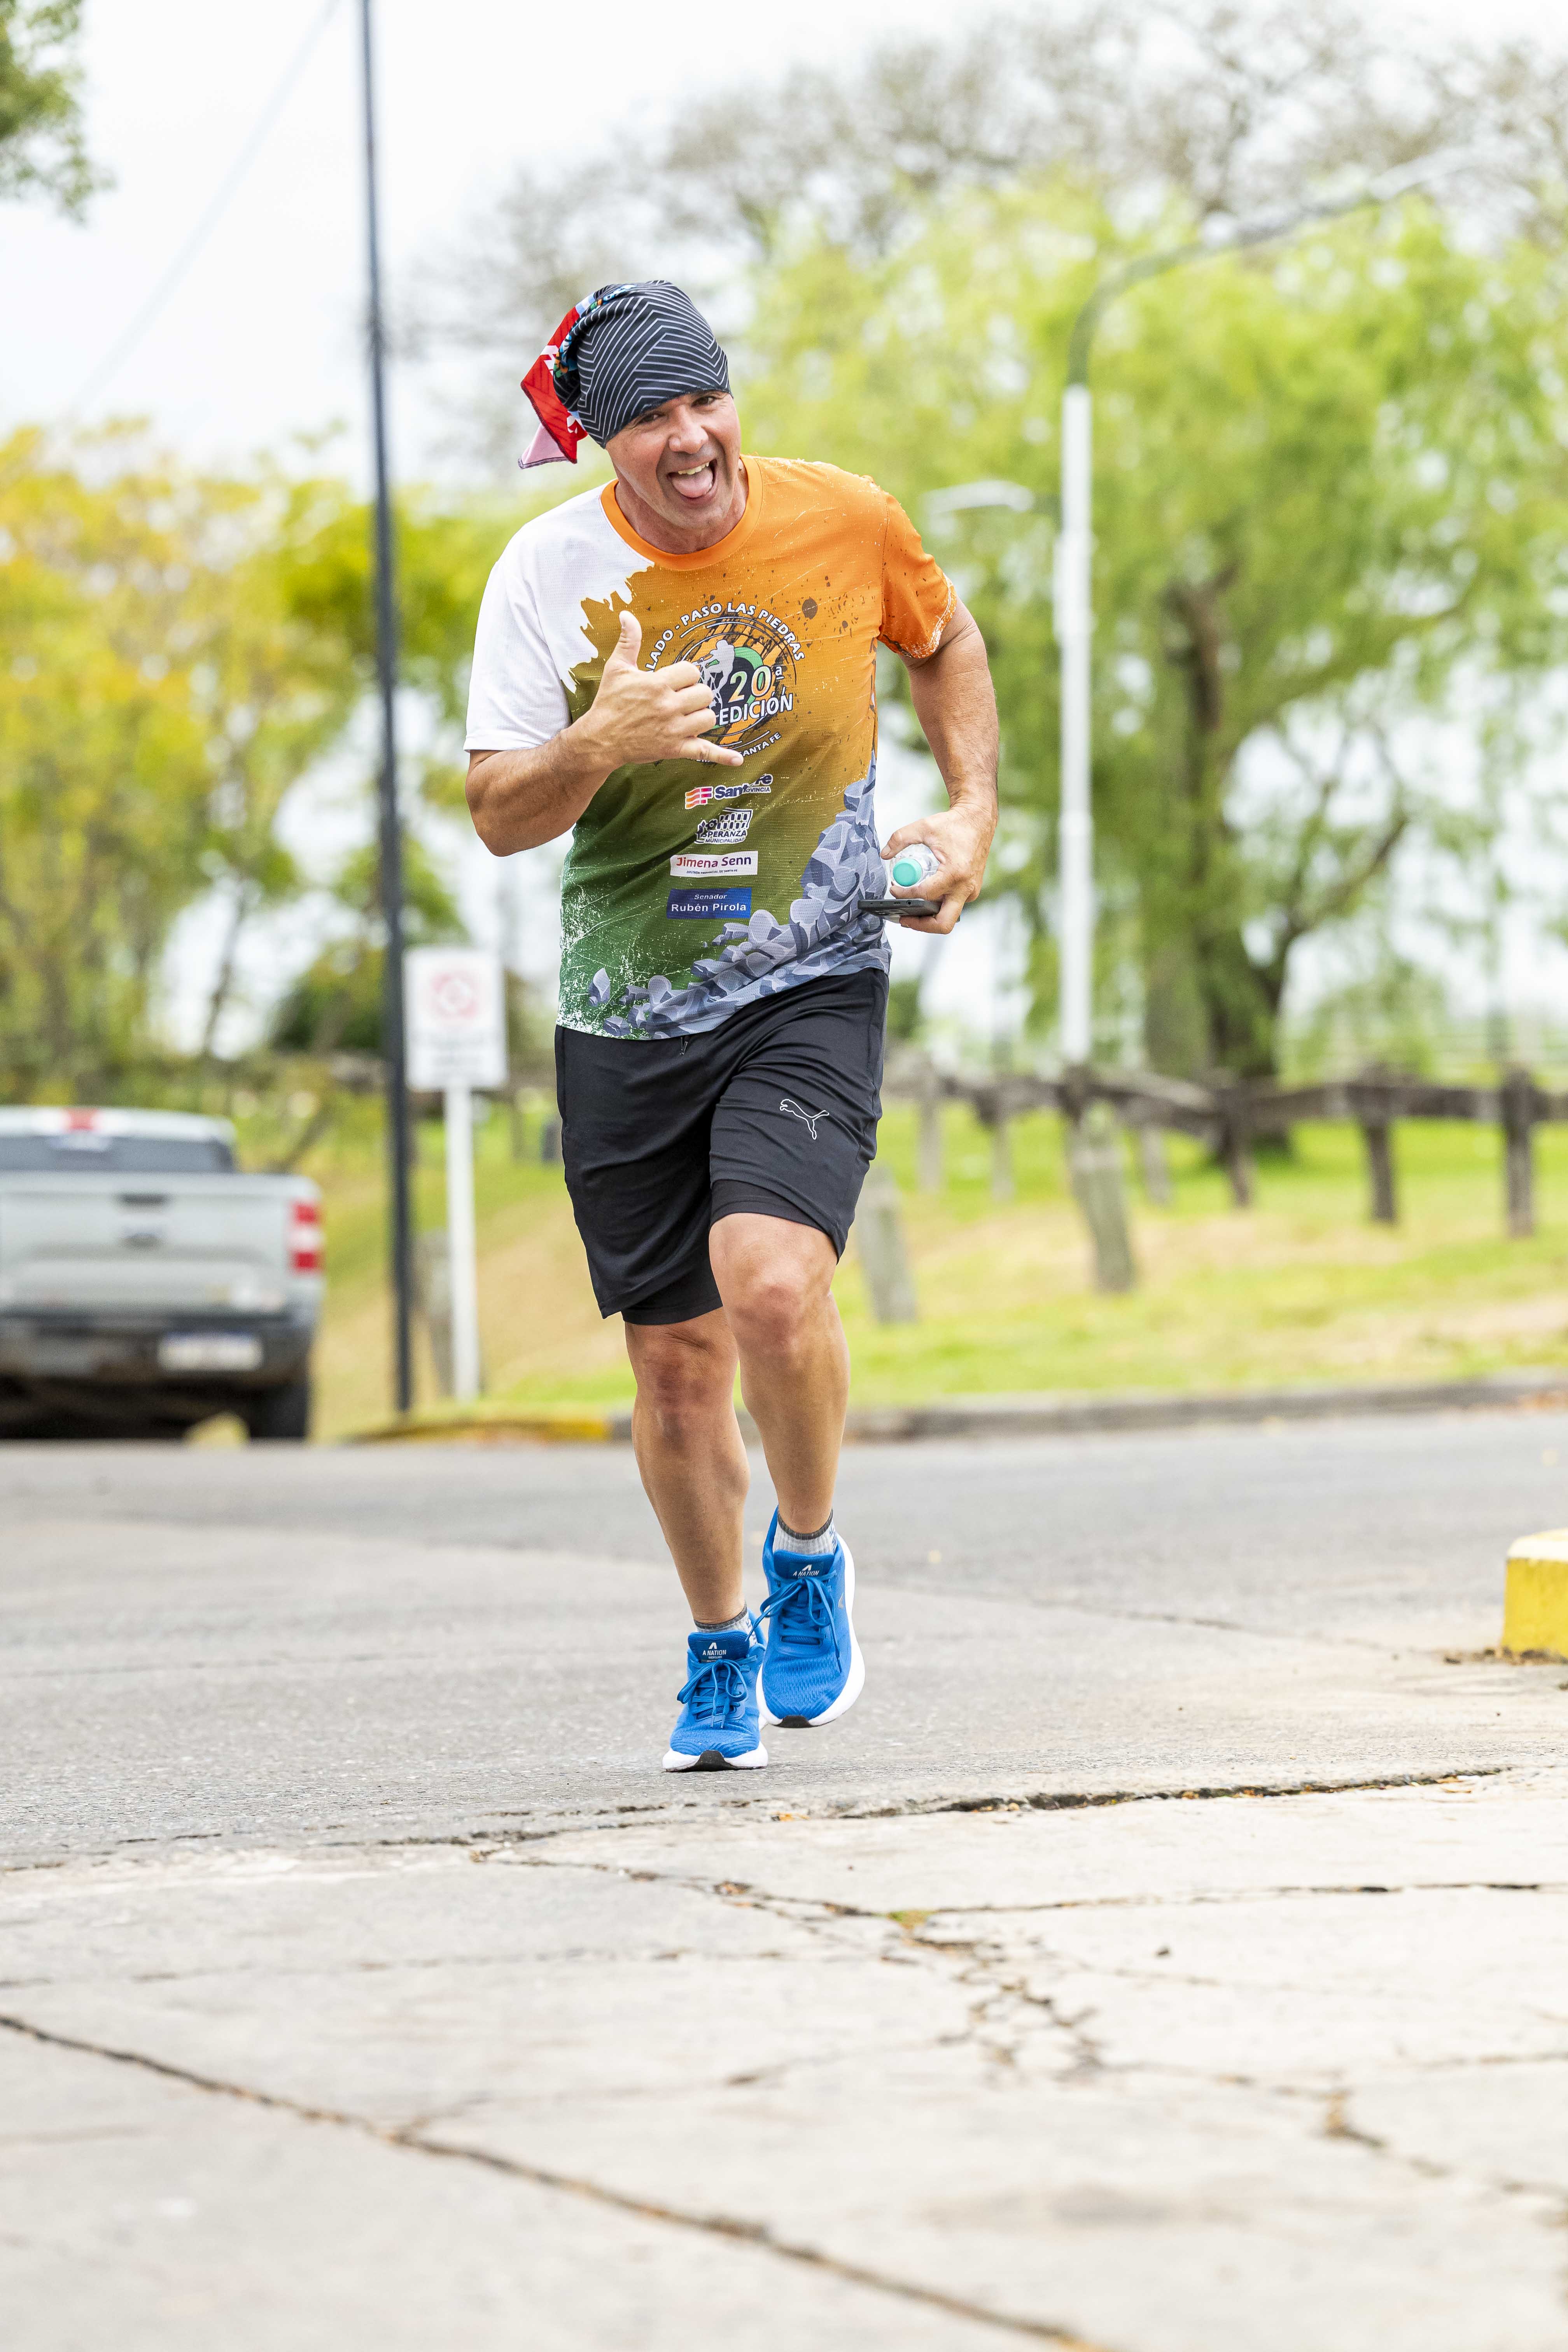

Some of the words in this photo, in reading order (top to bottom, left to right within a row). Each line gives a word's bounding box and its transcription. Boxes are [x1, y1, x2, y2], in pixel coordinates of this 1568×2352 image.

[646, 629, 674, 672] LADO
[681, 603, 723, 626] PASO
[727, 602, 756, 616] LAS
[758, 609, 805, 661] PIEDRAS
[719, 687, 793, 726] EDICIÓN
[739, 741, 770, 757] ANTA
[769, 732, 782, 744] FE
[676, 857, 719, 868] Jimena
[721, 857, 751, 866] Senn
[671, 903, 708, 912] Rubén
[713, 902, 747, 911] Pirola
